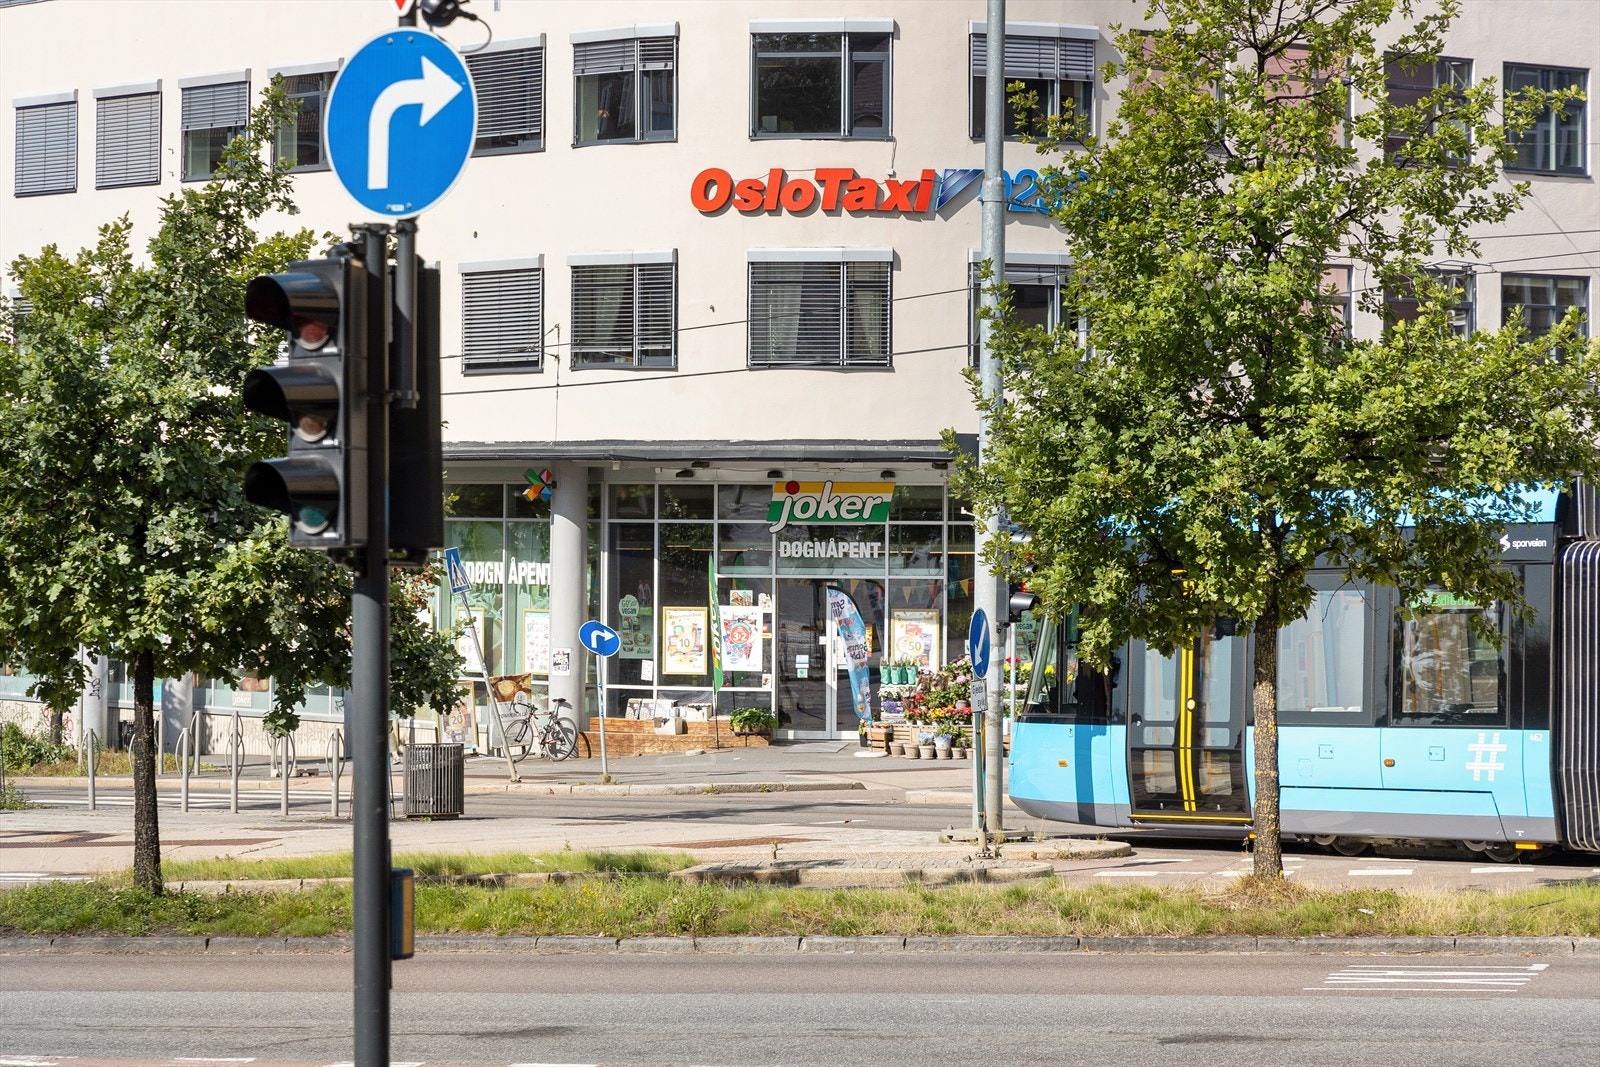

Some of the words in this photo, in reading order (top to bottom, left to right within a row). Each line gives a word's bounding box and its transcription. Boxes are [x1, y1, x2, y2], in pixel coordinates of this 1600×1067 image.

[690, 167, 938, 212] OsloTaxi
[769, 480, 884, 534] joker
[780, 538, 881, 558] DØGNÅPENT
[1512, 538, 1547, 549] sporveien
[909, 641, 922, 651] 50
[1529, 733, 1544, 742] 462
